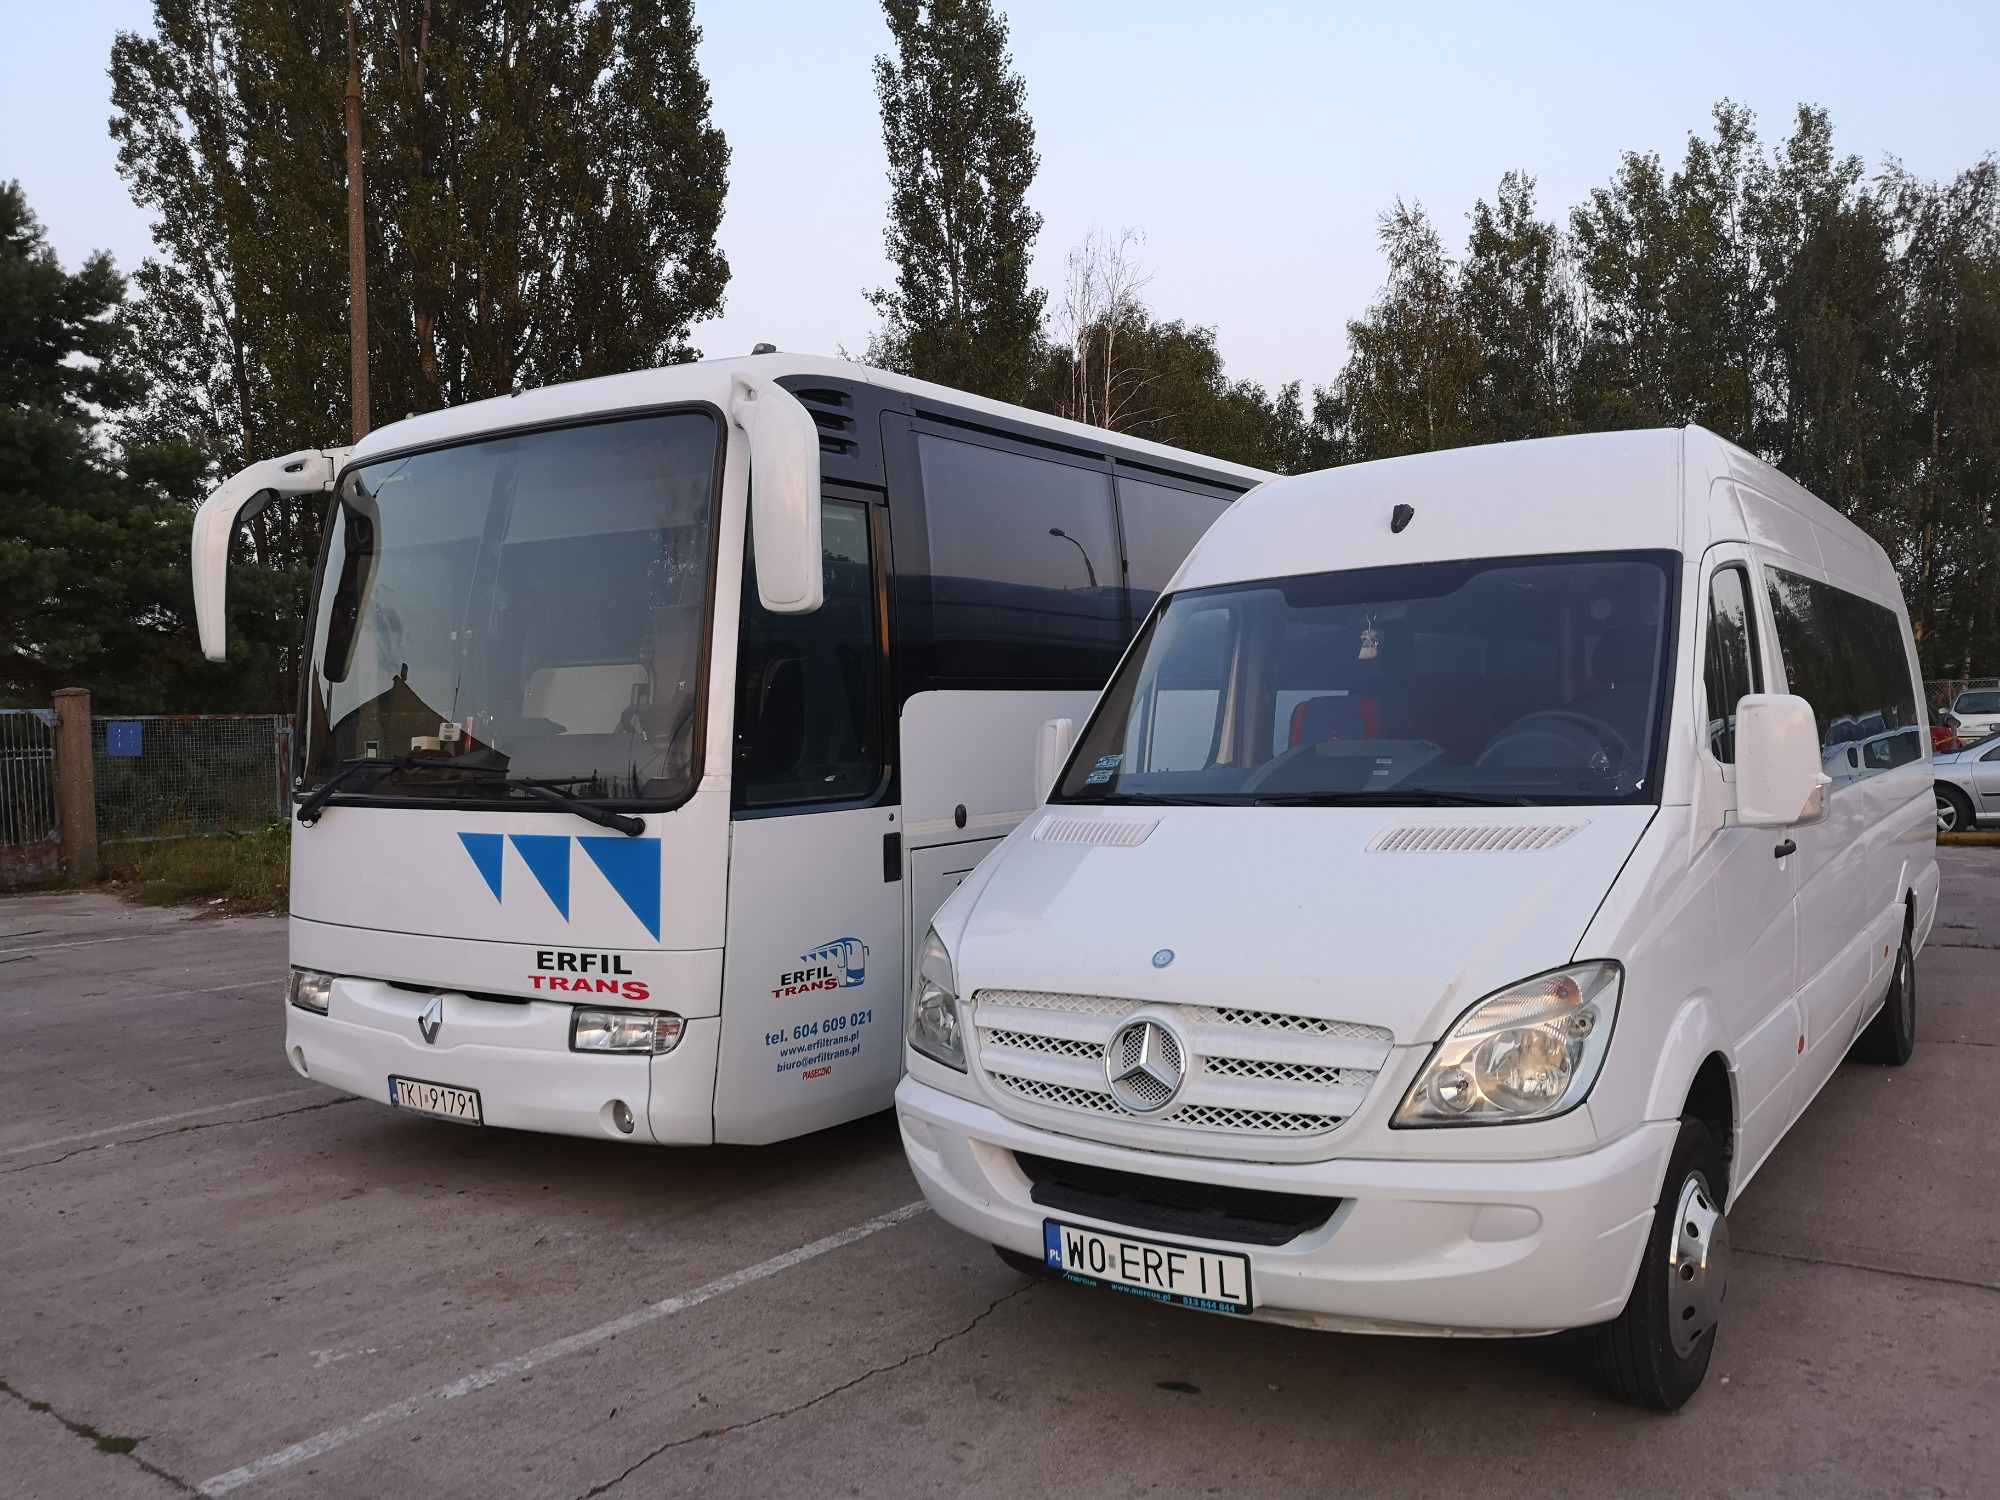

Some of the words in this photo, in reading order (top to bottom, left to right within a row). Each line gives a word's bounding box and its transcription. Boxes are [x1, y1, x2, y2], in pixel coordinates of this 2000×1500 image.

[536, 950, 633, 975] ERFIL
[527, 975, 651, 1001] TRANS
[771, 978, 838, 999] TRANS
[780, 966, 833, 986] ERFIL
[765, 1029, 788, 1046] tel.
[793, 1021, 819, 1040] 604
[822, 1015, 847, 1033] 609
[850, 1009, 872, 1027] 021
[780, 1030, 860, 1057] www.erfiltrans.pl
[777, 1043, 861, 1073] biuro@erfiltrans.pl
[802, 1065, 832, 1080] PIASECZNO
[398, 1081, 422, 1107] TKI
[430, 1088, 475, 1117] 91791
[1049, 1248, 1061, 1262] PL
[1066, 1231, 1106, 1273] WO
[1120, 1242, 1240, 1300] ERFIL
[1111, 1284, 1172, 1302] www.mercus.pl
